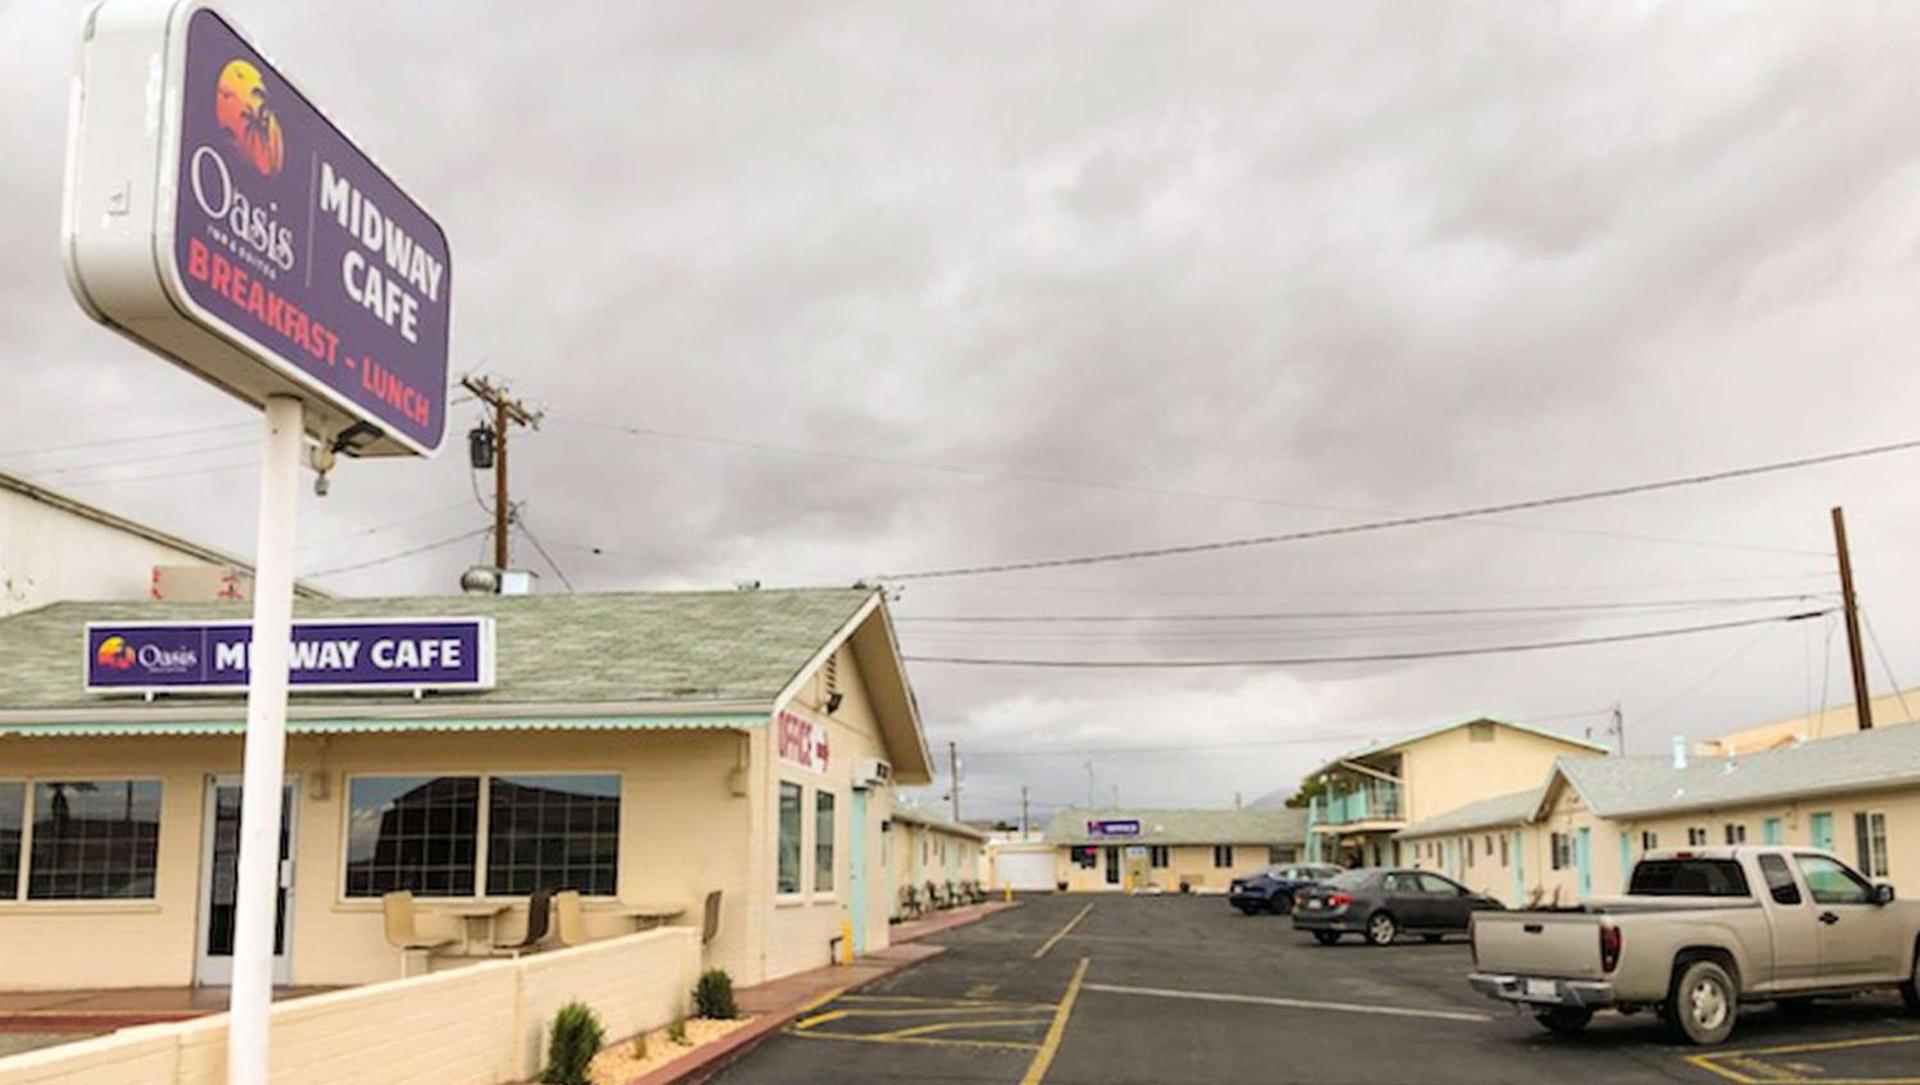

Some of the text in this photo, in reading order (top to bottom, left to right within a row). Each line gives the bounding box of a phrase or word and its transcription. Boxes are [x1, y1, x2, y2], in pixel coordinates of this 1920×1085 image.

[190, 145, 294, 270] Oasis
[320, 161, 443, 302] MIDWAY
[188, 236, 339, 367] BREAKFAST
[362, 356, 430, 428] LUNCH
[342, 249, 419, 344] CAFE
[138, 643, 198, 669] Oasis
[216, 639, 462, 671] MWAY CAFE
